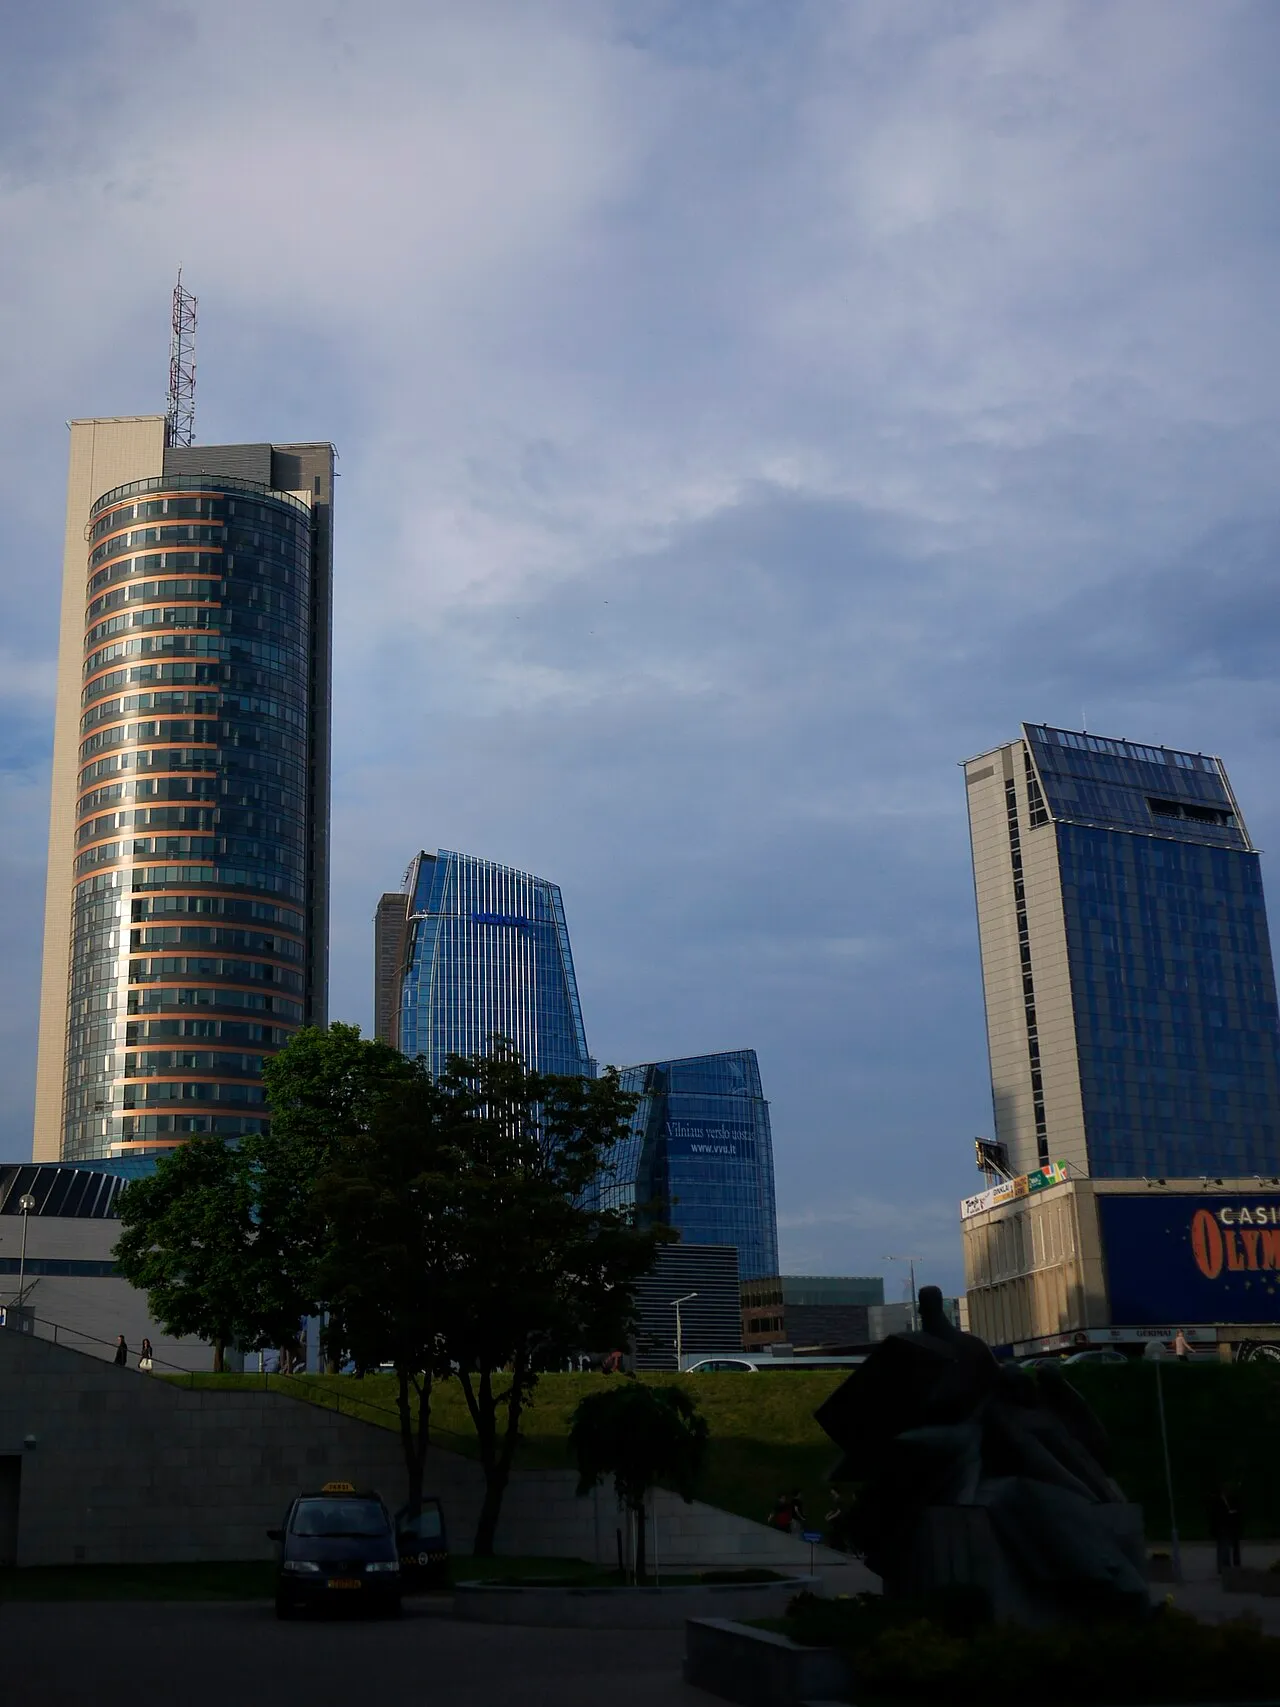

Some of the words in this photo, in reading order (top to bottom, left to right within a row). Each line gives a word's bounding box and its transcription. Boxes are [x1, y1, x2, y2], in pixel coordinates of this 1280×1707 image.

[665, 1121, 703, 1138] Vilniaus
[706, 1123, 730, 1139] verslo
[1219, 1206, 1280, 1225] CASI
